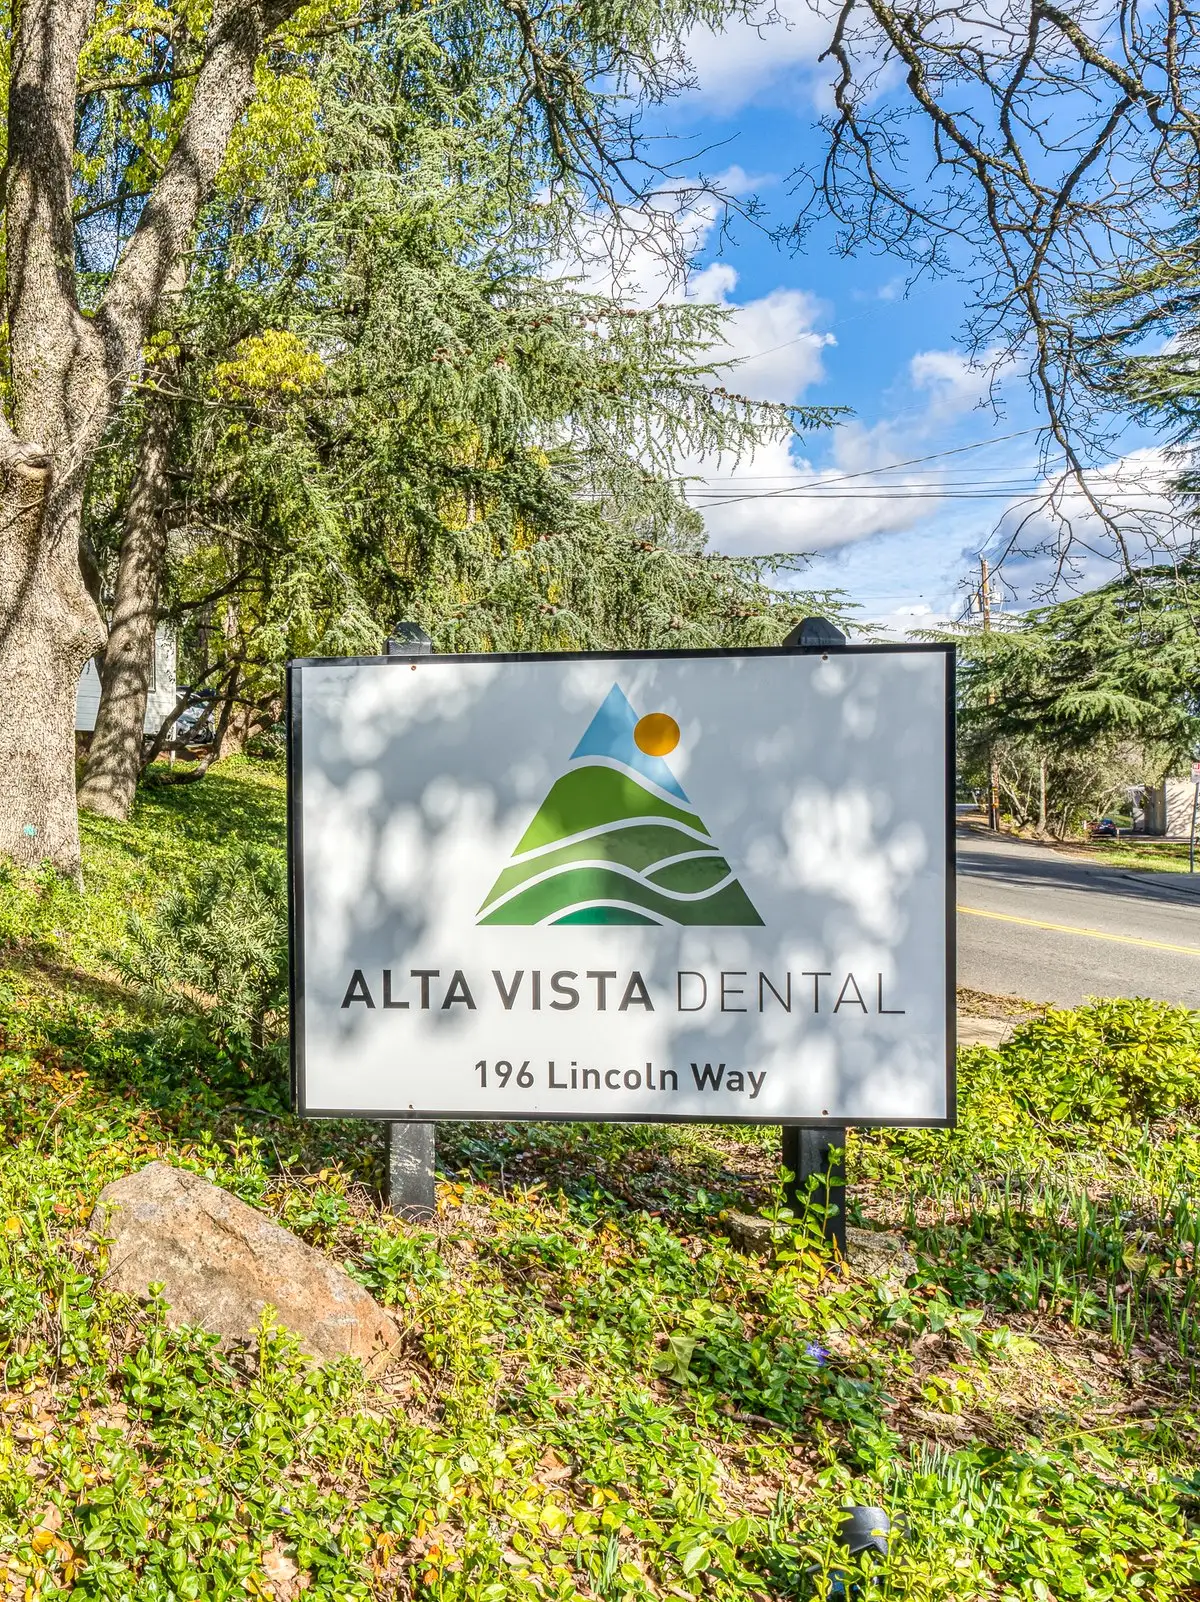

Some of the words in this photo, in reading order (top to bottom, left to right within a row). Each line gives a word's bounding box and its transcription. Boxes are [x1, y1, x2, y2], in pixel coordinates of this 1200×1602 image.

[340, 968, 478, 1010] ALTA
[491, 969, 655, 1012] VISTA
[676, 970, 906, 1015] DENTAL
[474, 1060, 535, 1089] 196
[547, 1061, 679, 1091] Lincoln
[690, 1062, 768, 1100] Way
